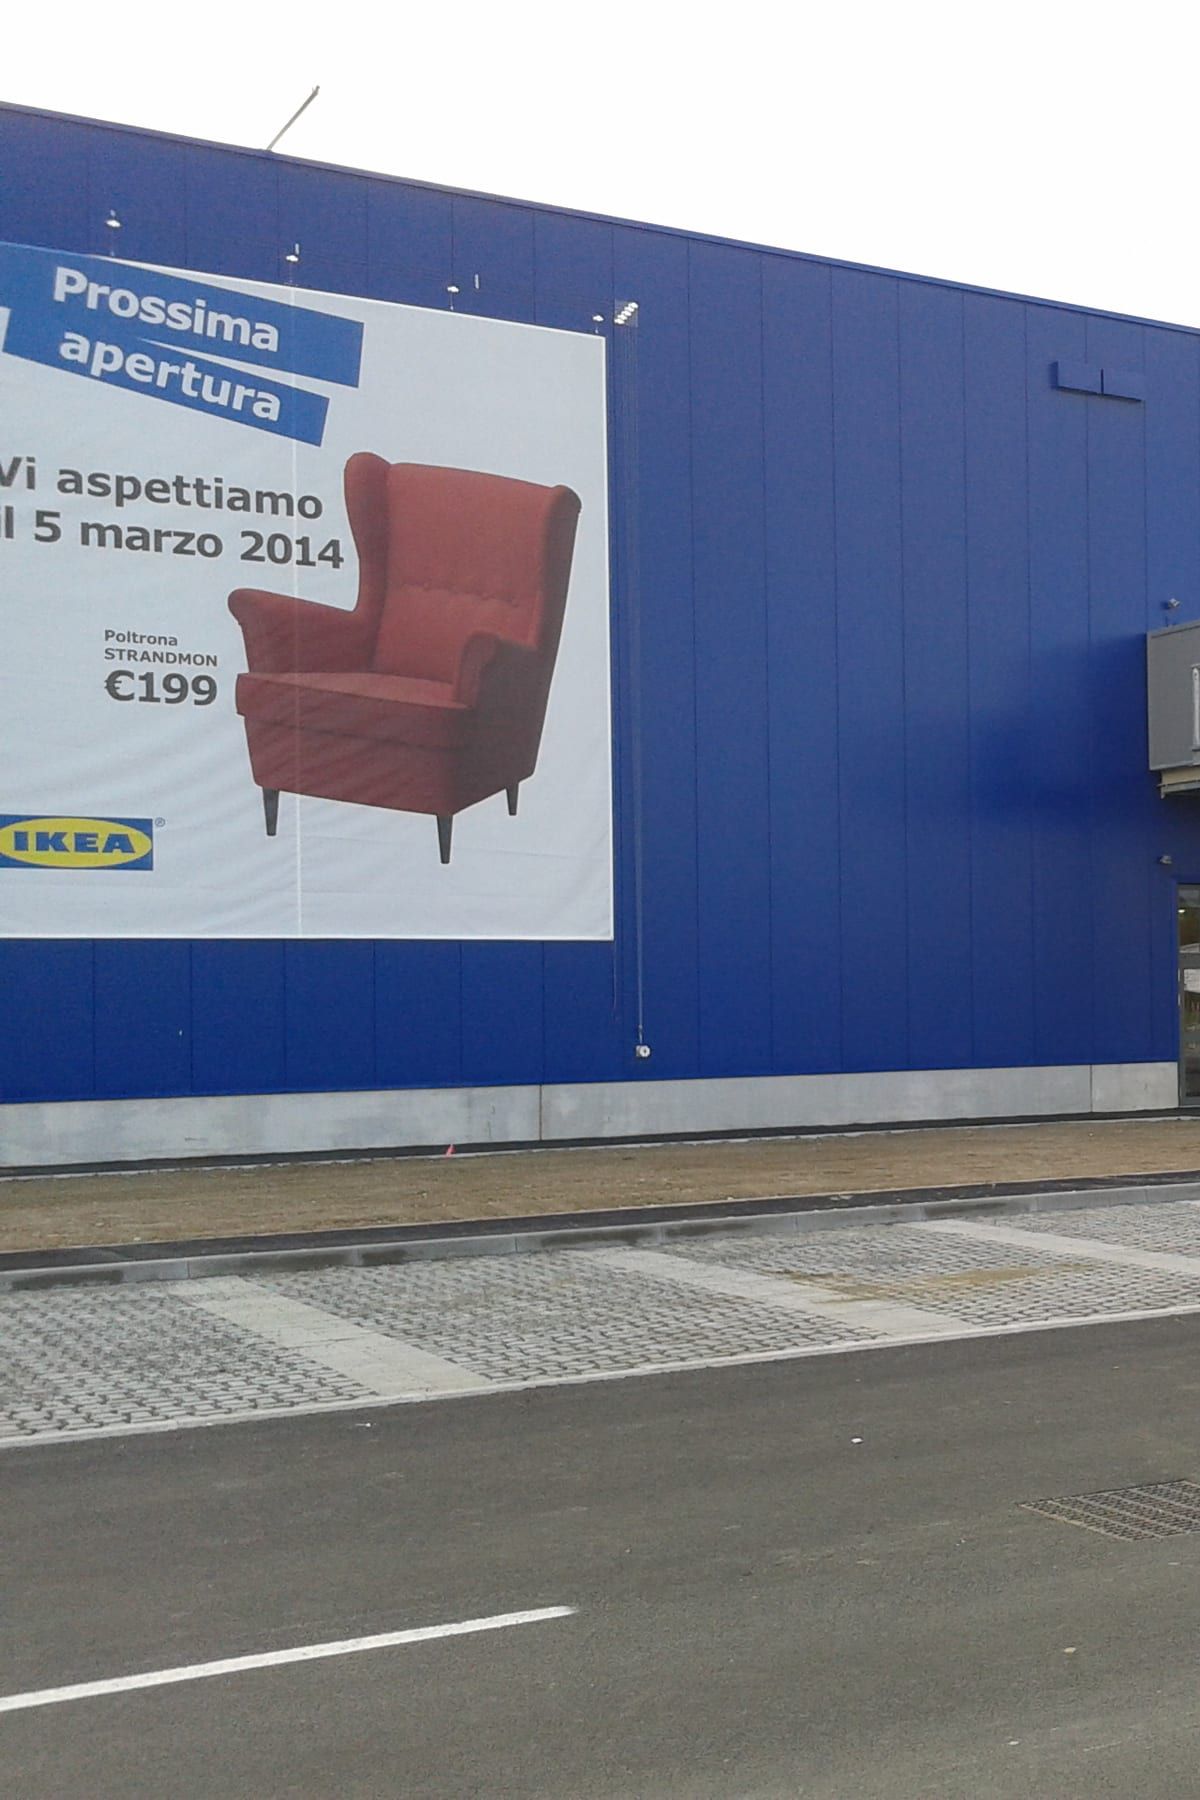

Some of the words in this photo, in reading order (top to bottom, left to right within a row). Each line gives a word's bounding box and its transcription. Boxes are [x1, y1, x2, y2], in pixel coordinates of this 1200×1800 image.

[53, 267, 279, 352] Prossima
[60, 331, 281, 421] apertura
[0, 456, 36, 490] Vi
[57, 468, 323, 519] aspettiamo
[0, 505, 14, 539] l
[34, 509, 62, 543] 5
[80, 521, 223, 558] marzo
[240, 530, 344, 569] 2014
[104, 629, 178, 646] Poltrona
[104, 648, 218, 667] STRANDMON
[104, 669, 218, 706] €199
[14, 831, 135, 853] IKEA
